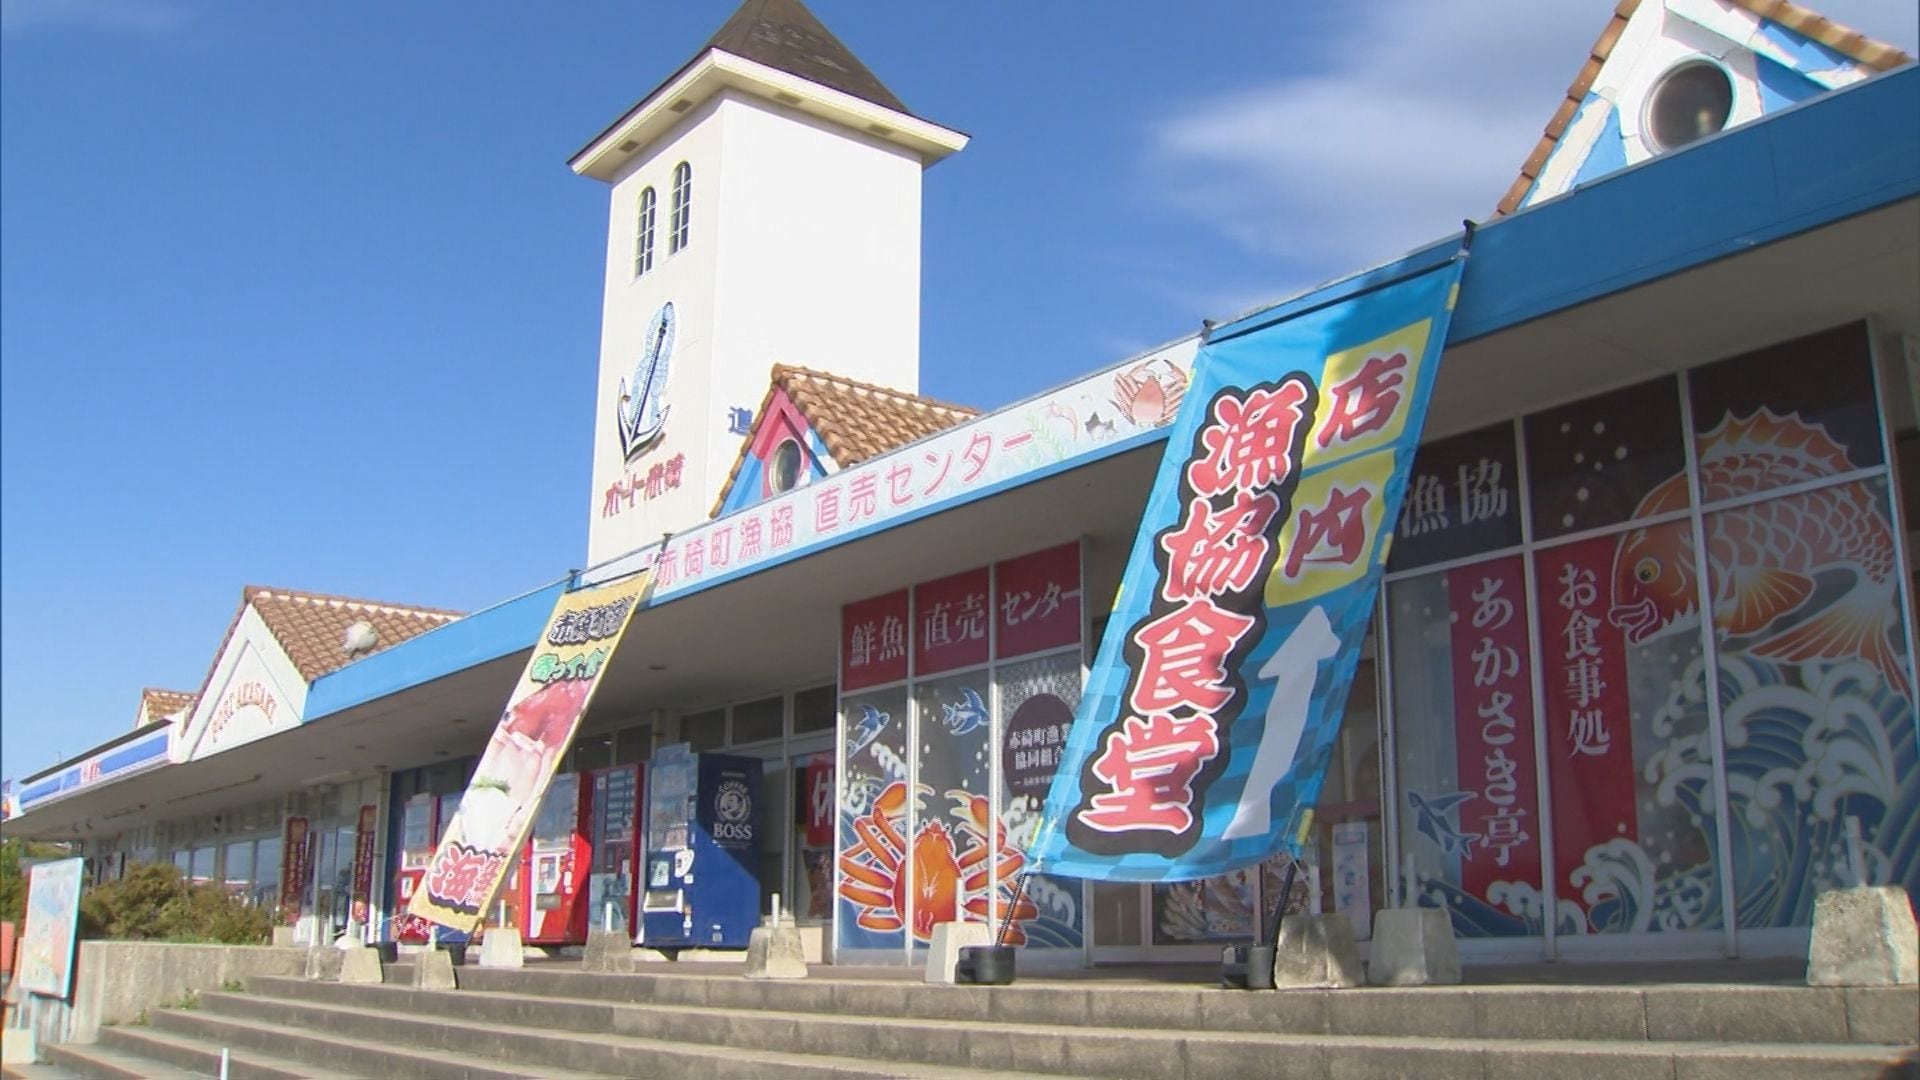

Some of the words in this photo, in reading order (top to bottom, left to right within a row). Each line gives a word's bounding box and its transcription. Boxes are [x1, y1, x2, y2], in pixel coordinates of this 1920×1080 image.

[814, 430, 1034, 533] 直売センター
[1285, 352, 1407, 579] 店内
[1401, 459, 1508, 538] 漁協
[850, 614, 905, 667] 鮮魚
[924, 593, 985, 652] 直売
[1001, 580, 1081, 627] センター
[1076, 378, 1308, 834] 漁協食堂
[1557, 561, 1611, 759] お食事処
[1470, 576, 1530, 867] あかさき亭
[713, 822, 753, 840] BOSS
